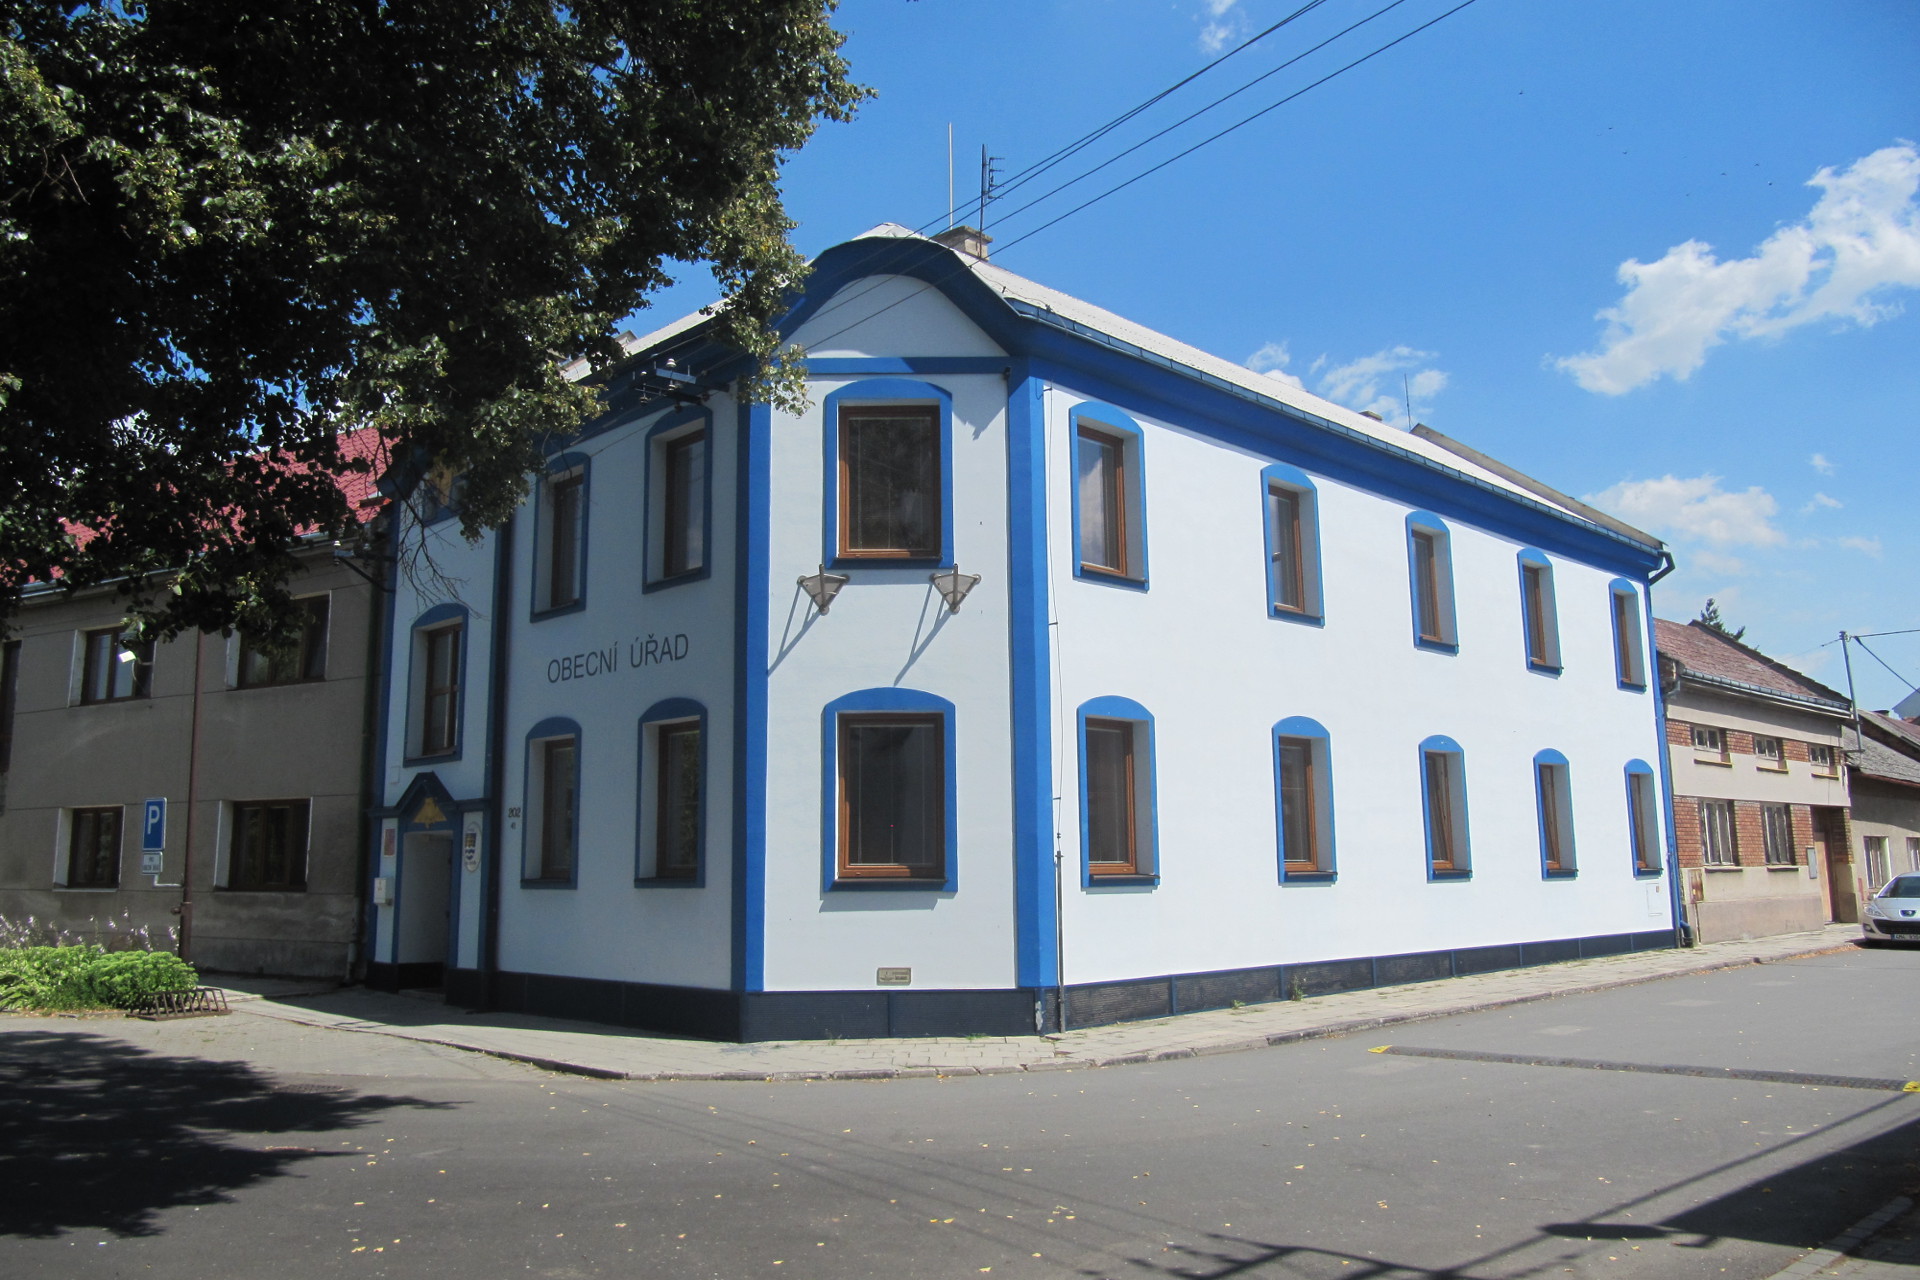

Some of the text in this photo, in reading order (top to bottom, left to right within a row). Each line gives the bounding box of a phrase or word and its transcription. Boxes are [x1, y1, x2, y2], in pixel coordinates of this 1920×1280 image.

[547, 633, 689, 684] OBECNÍ ÚŘAD
[147, 805, 160, 834] P
